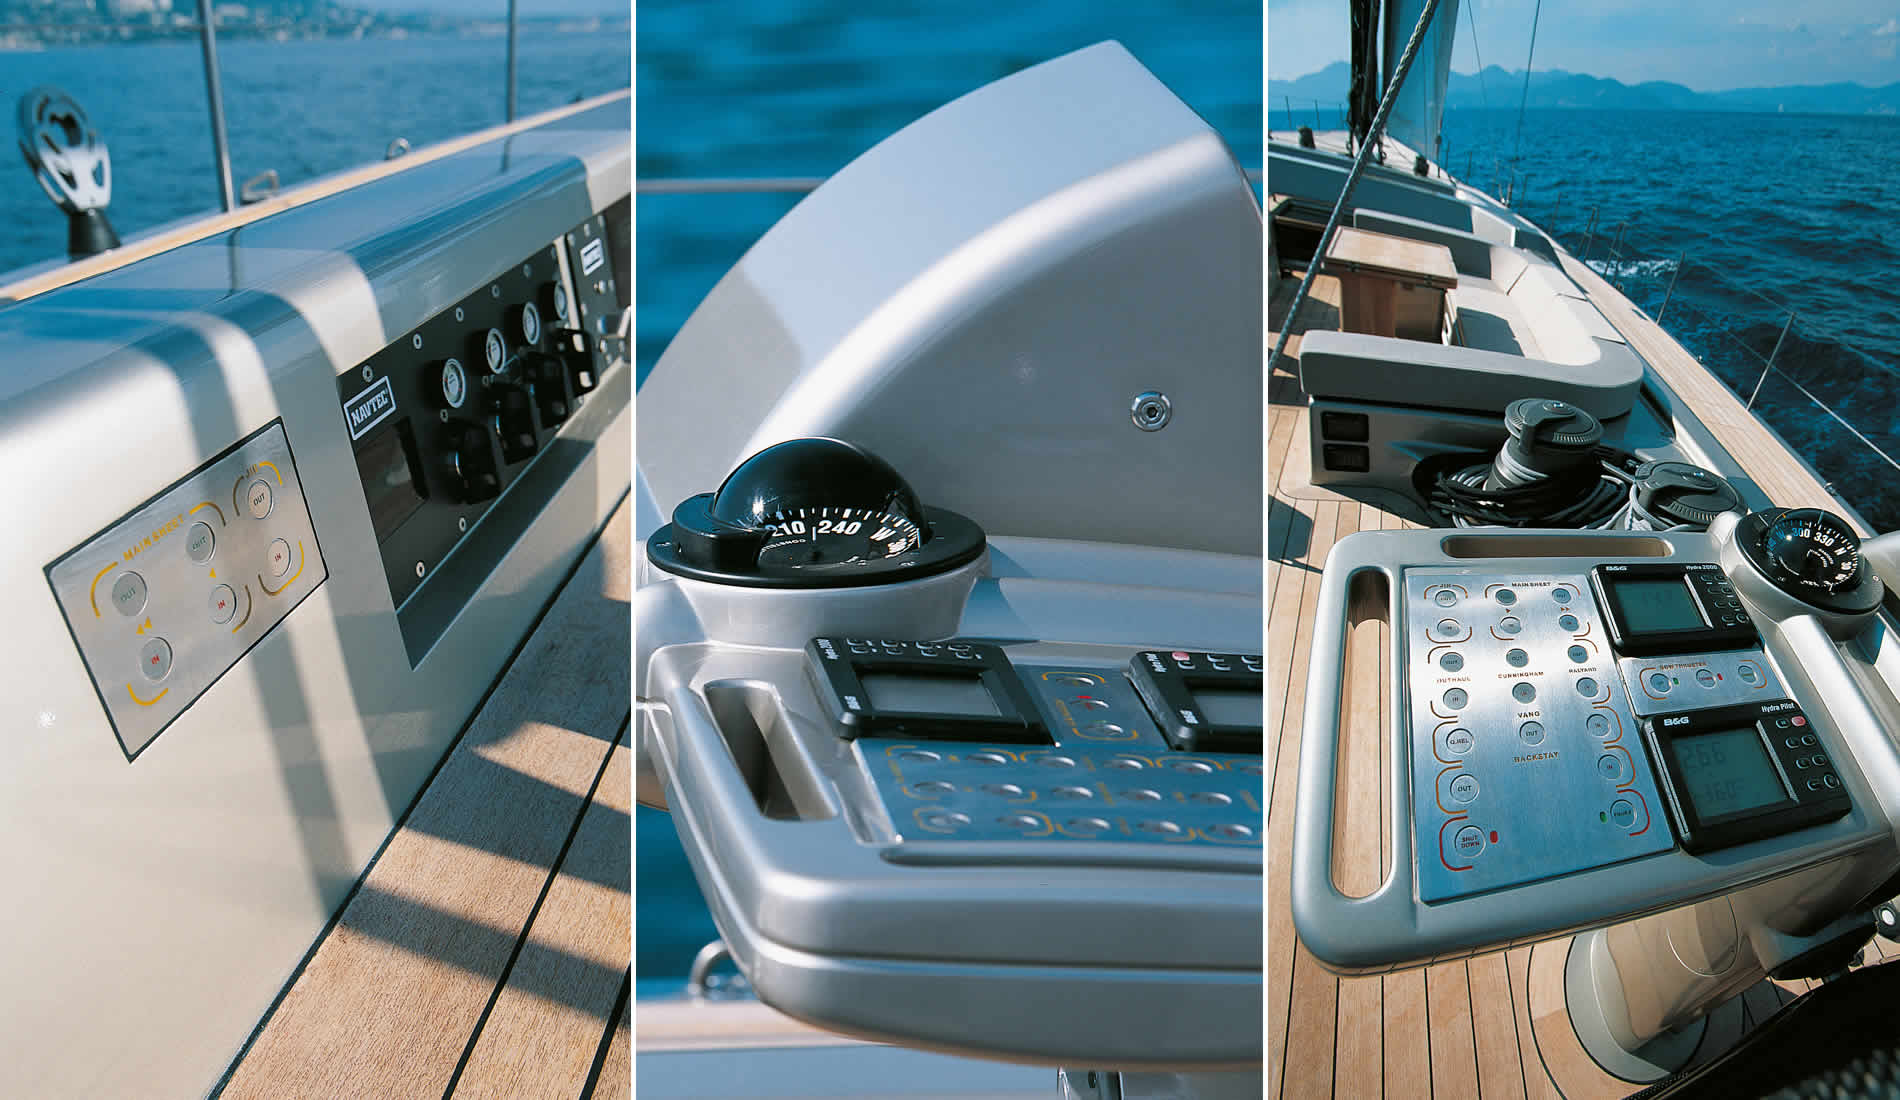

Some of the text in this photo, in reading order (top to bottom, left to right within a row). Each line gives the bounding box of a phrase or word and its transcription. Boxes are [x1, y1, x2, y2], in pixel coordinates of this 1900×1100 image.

[350, 388, 389, 427] NAVTEC
[253, 492, 265, 506] OUT
[817, 519, 862, 535] 240
[869, 526, 897, 541] W
[1791, 527, 1811, 539] 300
[1813, 532, 1835, 547] 330
[1833, 547, 1848, 556] N
[120, 587, 136, 601] OUT
[217, 599, 225, 609] IN
[151, 655, 161, 665] IN
[1497, 671, 1544, 679] CUNNINGHAM
[1761, 702, 1795, 713] Hydra Pilot
[1517, 710, 1540, 718] VANG
[1663, 716, 1689, 726] B&G
[1513, 751, 1559, 763] BACKSTAY
[1461, 834, 1478, 843] SHUT
[1460, 841, 1480, 849] DOWN
